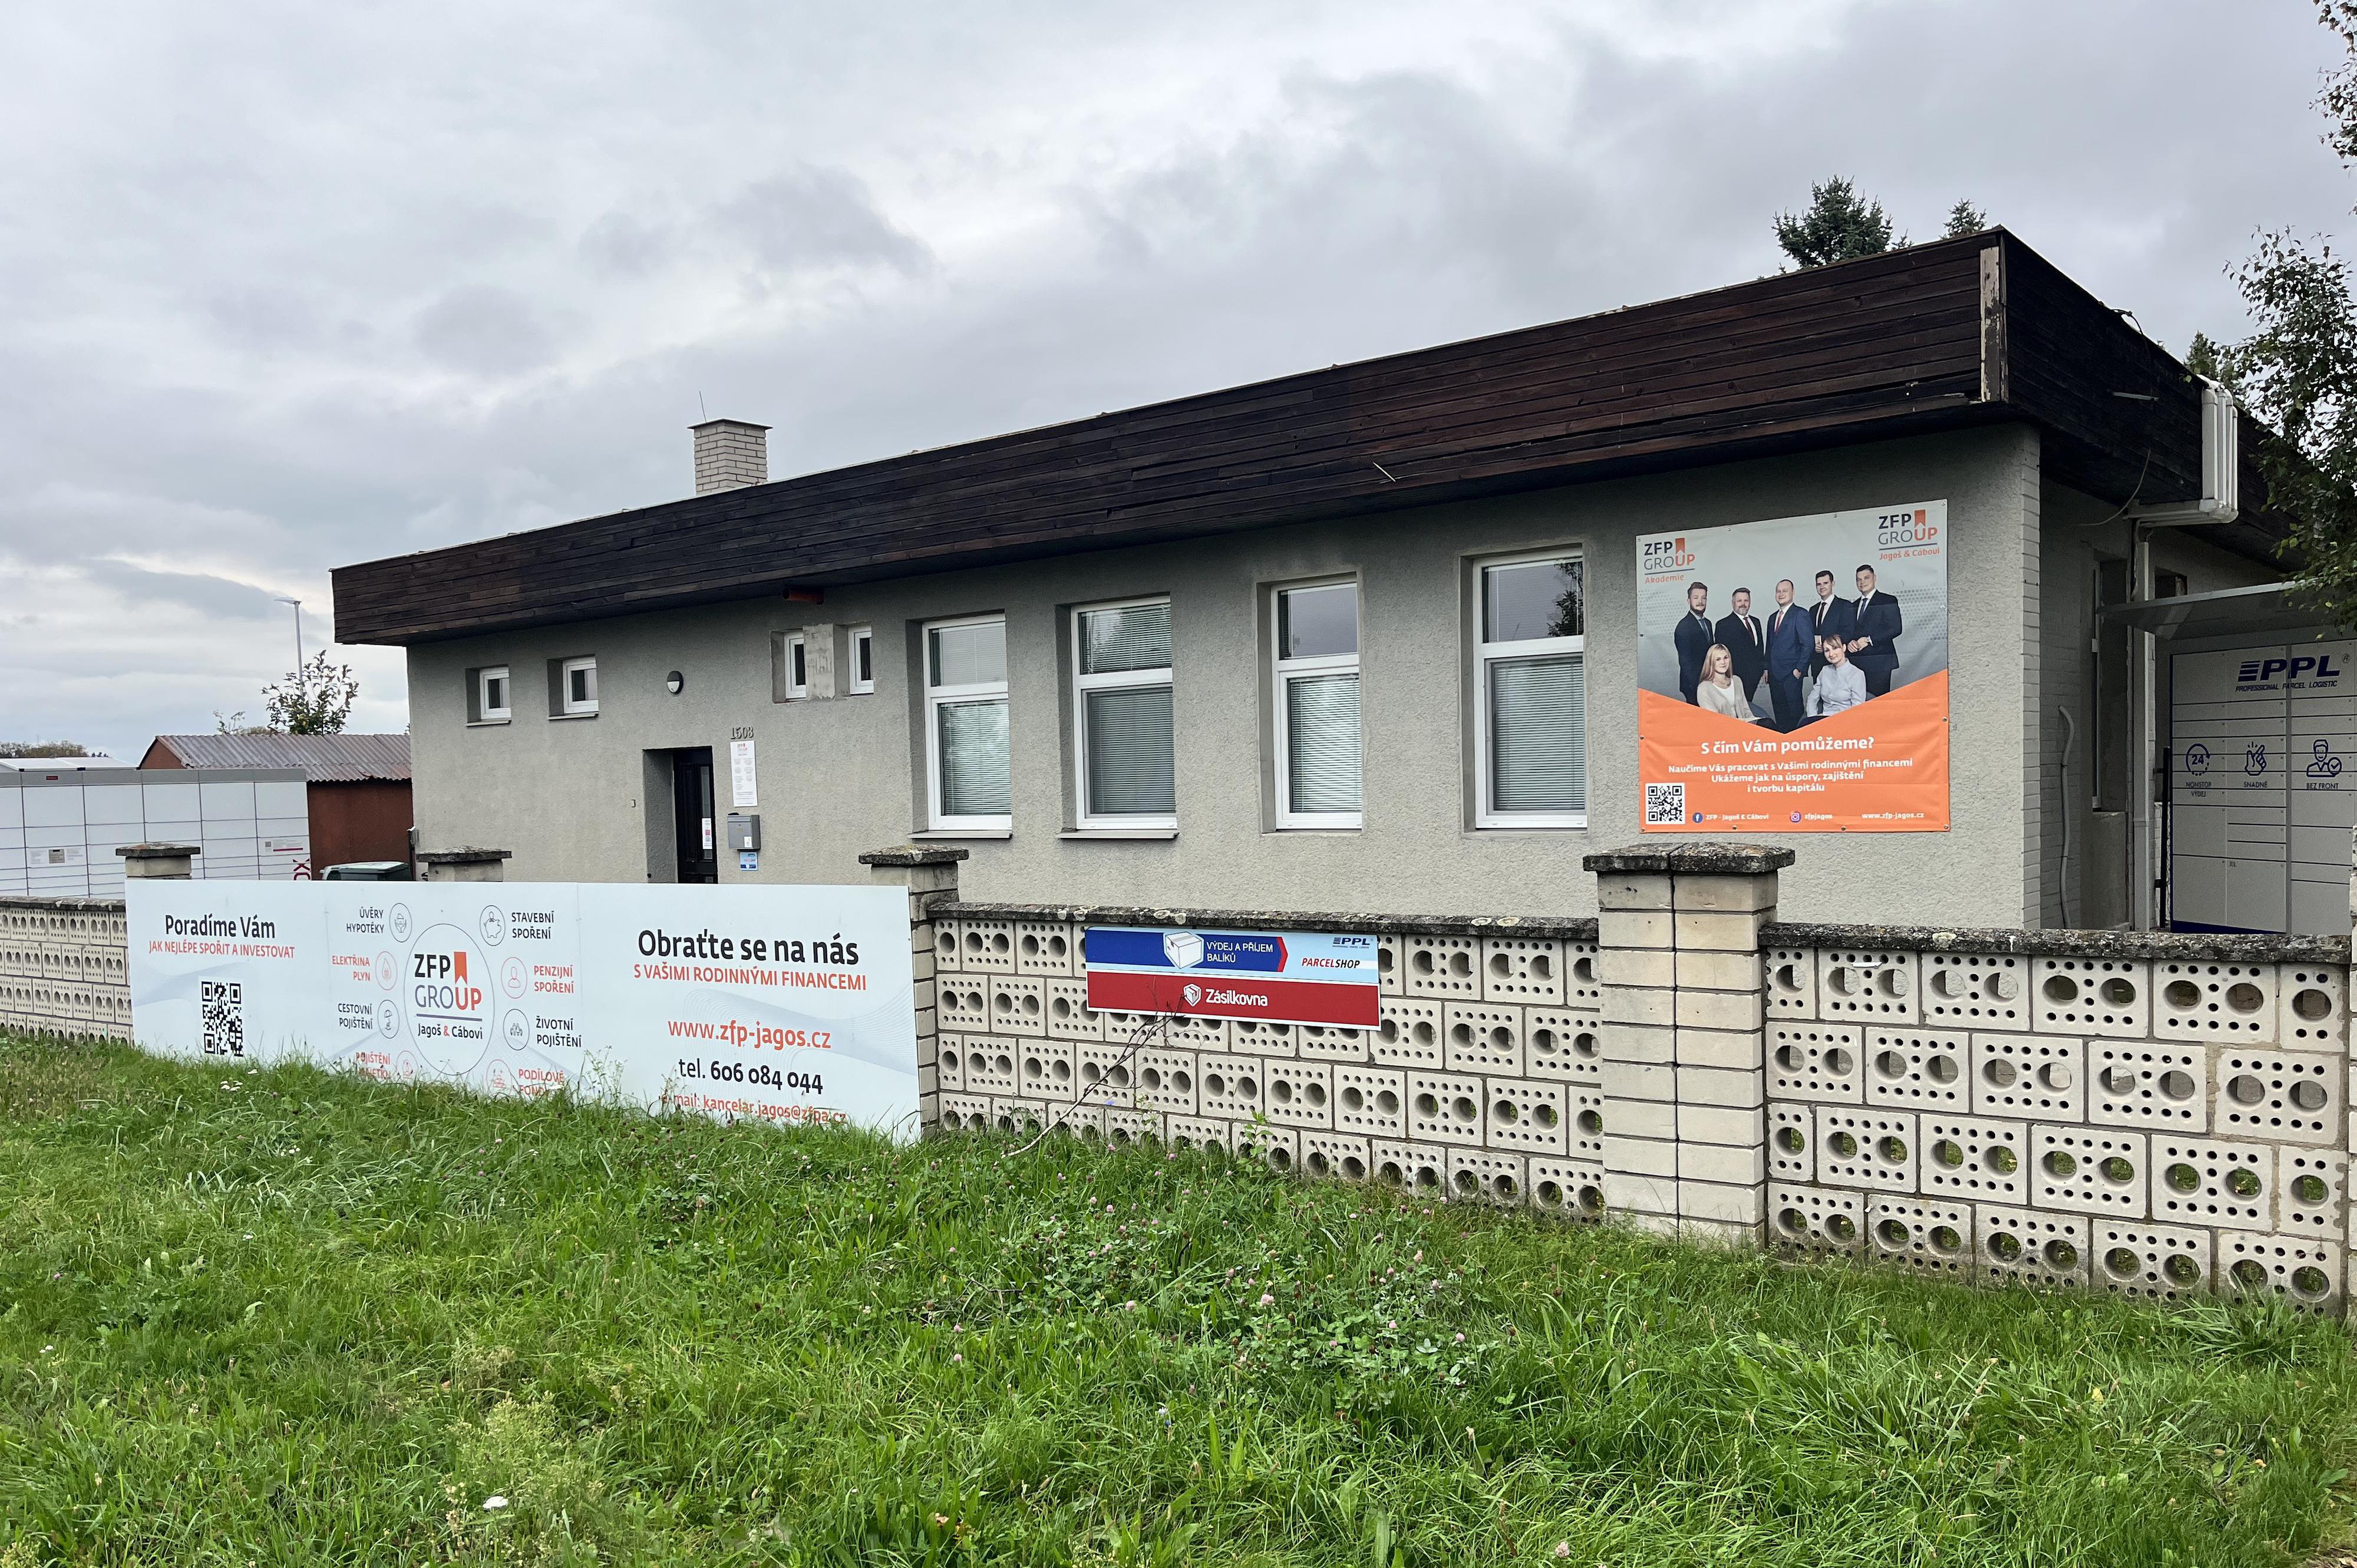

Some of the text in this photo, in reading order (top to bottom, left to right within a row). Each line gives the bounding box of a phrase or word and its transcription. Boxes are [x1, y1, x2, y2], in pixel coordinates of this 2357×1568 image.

[1879, 513, 1912, 529] ZFP
[1879, 527, 1937, 544] GROUP
[1644, 542, 1673, 556] ZFP
[1644, 554, 1695, 570] GROUP
[1645, 575, 1684, 583] Akademie
[2260, 655, 2341, 681] PPL
[2309, 680, 2338, 688] LOGISTIC
[1701, 736, 1874, 754] S čím Vám pomůžeme?
[1669, 764, 1707, 773] Naučíme
[1708, 763, 1725, 772] Vás
[1727, 763, 1768, 773] pracovat
[1777, 761, 1808, 770] Vašimi
[1811, 759, 1860, 770] rodinnými
[1863, 758, 1913, 769] financemi
[2192, 754, 2204, 765] 24
[1711, 774, 1753, 783] Ukážeme
[1755, 773, 1769, 783] jak
[1785, 773, 1821, 783] úspory,
[1823, 771, 1864, 782] zajištění
[1752, 784, 1784, 793] tvorbu
[1786, 783, 1825, 794] kapitálu
[1804, 813, 1833, 821] zfpjagos
[359, 906, 384, 919] ÚVĚRY
[511, 911, 554, 923] STAVEBNÍ
[165, 913, 275, 939] Poradíme Vám
[346, 922, 384, 934] HYPOTÉKY
[512, 926, 551, 940] SPOŘENÍ
[638, 929, 859, 965] Obraťte se na nás
[1206, 940, 1273, 952] VÝDEJ A PŘÍJEM
[1341, 937, 1370, 945] PPL
[149, 939, 295, 958] JAK NEJLÉPE SPOŘIT A INVESTOVAT
[332, 955, 370, 967] ELEKTŘINA
[1207, 952, 1236, 963] BALÍKŮ
[1302, 958, 1360, 969] PARCELSHOP
[414, 954, 451, 979] ZFP
[534, 965, 573, 978] PENZIJNÍ
[353, 972, 371, 982] PLYN
[633, 962, 867, 991] S VAŠIMI RODINNÝMI FINANCEMI
[534, 979, 574, 994] SPOŘENÍ
[415, 984, 482, 1011] GROUP
[1206, 989, 1268, 1006] Zásilkovna
[338, 1003, 372, 1015] CESTOVNÍ
[339, 1017, 373, 1030] POJIŠTĚNÍ
[536, 1016, 573, 1031] ŽIVOTNÍ
[418, 1023, 483, 1039] Jagoš & Cábovi
[668, 1019, 831, 1051] www.zfp-jagos.cz
[537, 1033, 582, 1048] POJIŠTĚNÍ
[519, 1068, 564, 1082] PODÍLOVÉ
[678, 1058, 823, 1095] tel. 606 084 044
